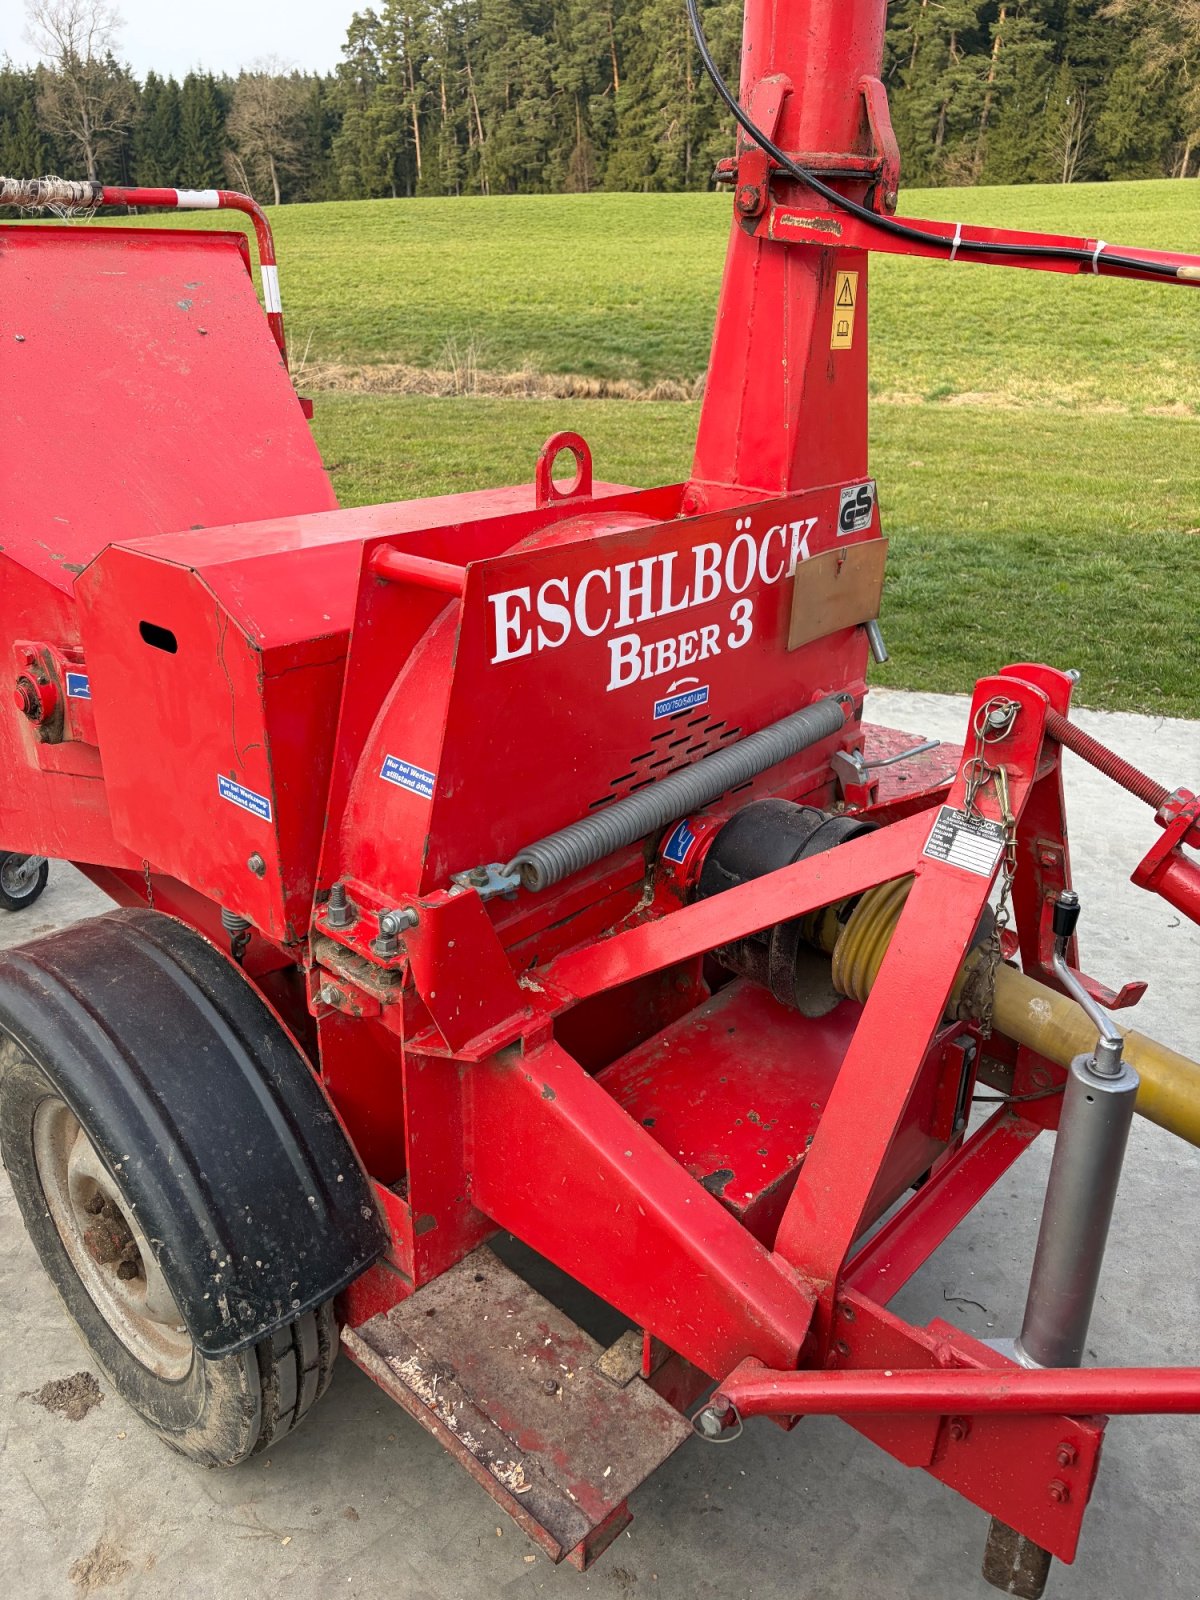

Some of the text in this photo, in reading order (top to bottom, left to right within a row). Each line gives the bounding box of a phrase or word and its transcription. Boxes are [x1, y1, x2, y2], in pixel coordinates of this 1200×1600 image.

[488, 516, 819, 665] ESCHLBÖCK
[606, 598, 754, 692] BIBER 3
[387, 759, 399, 769] Nur
[399, 764, 410, 774] bei
[220, 779, 230, 789] Nur
[386, 771, 433, 795] stillstand öffne
